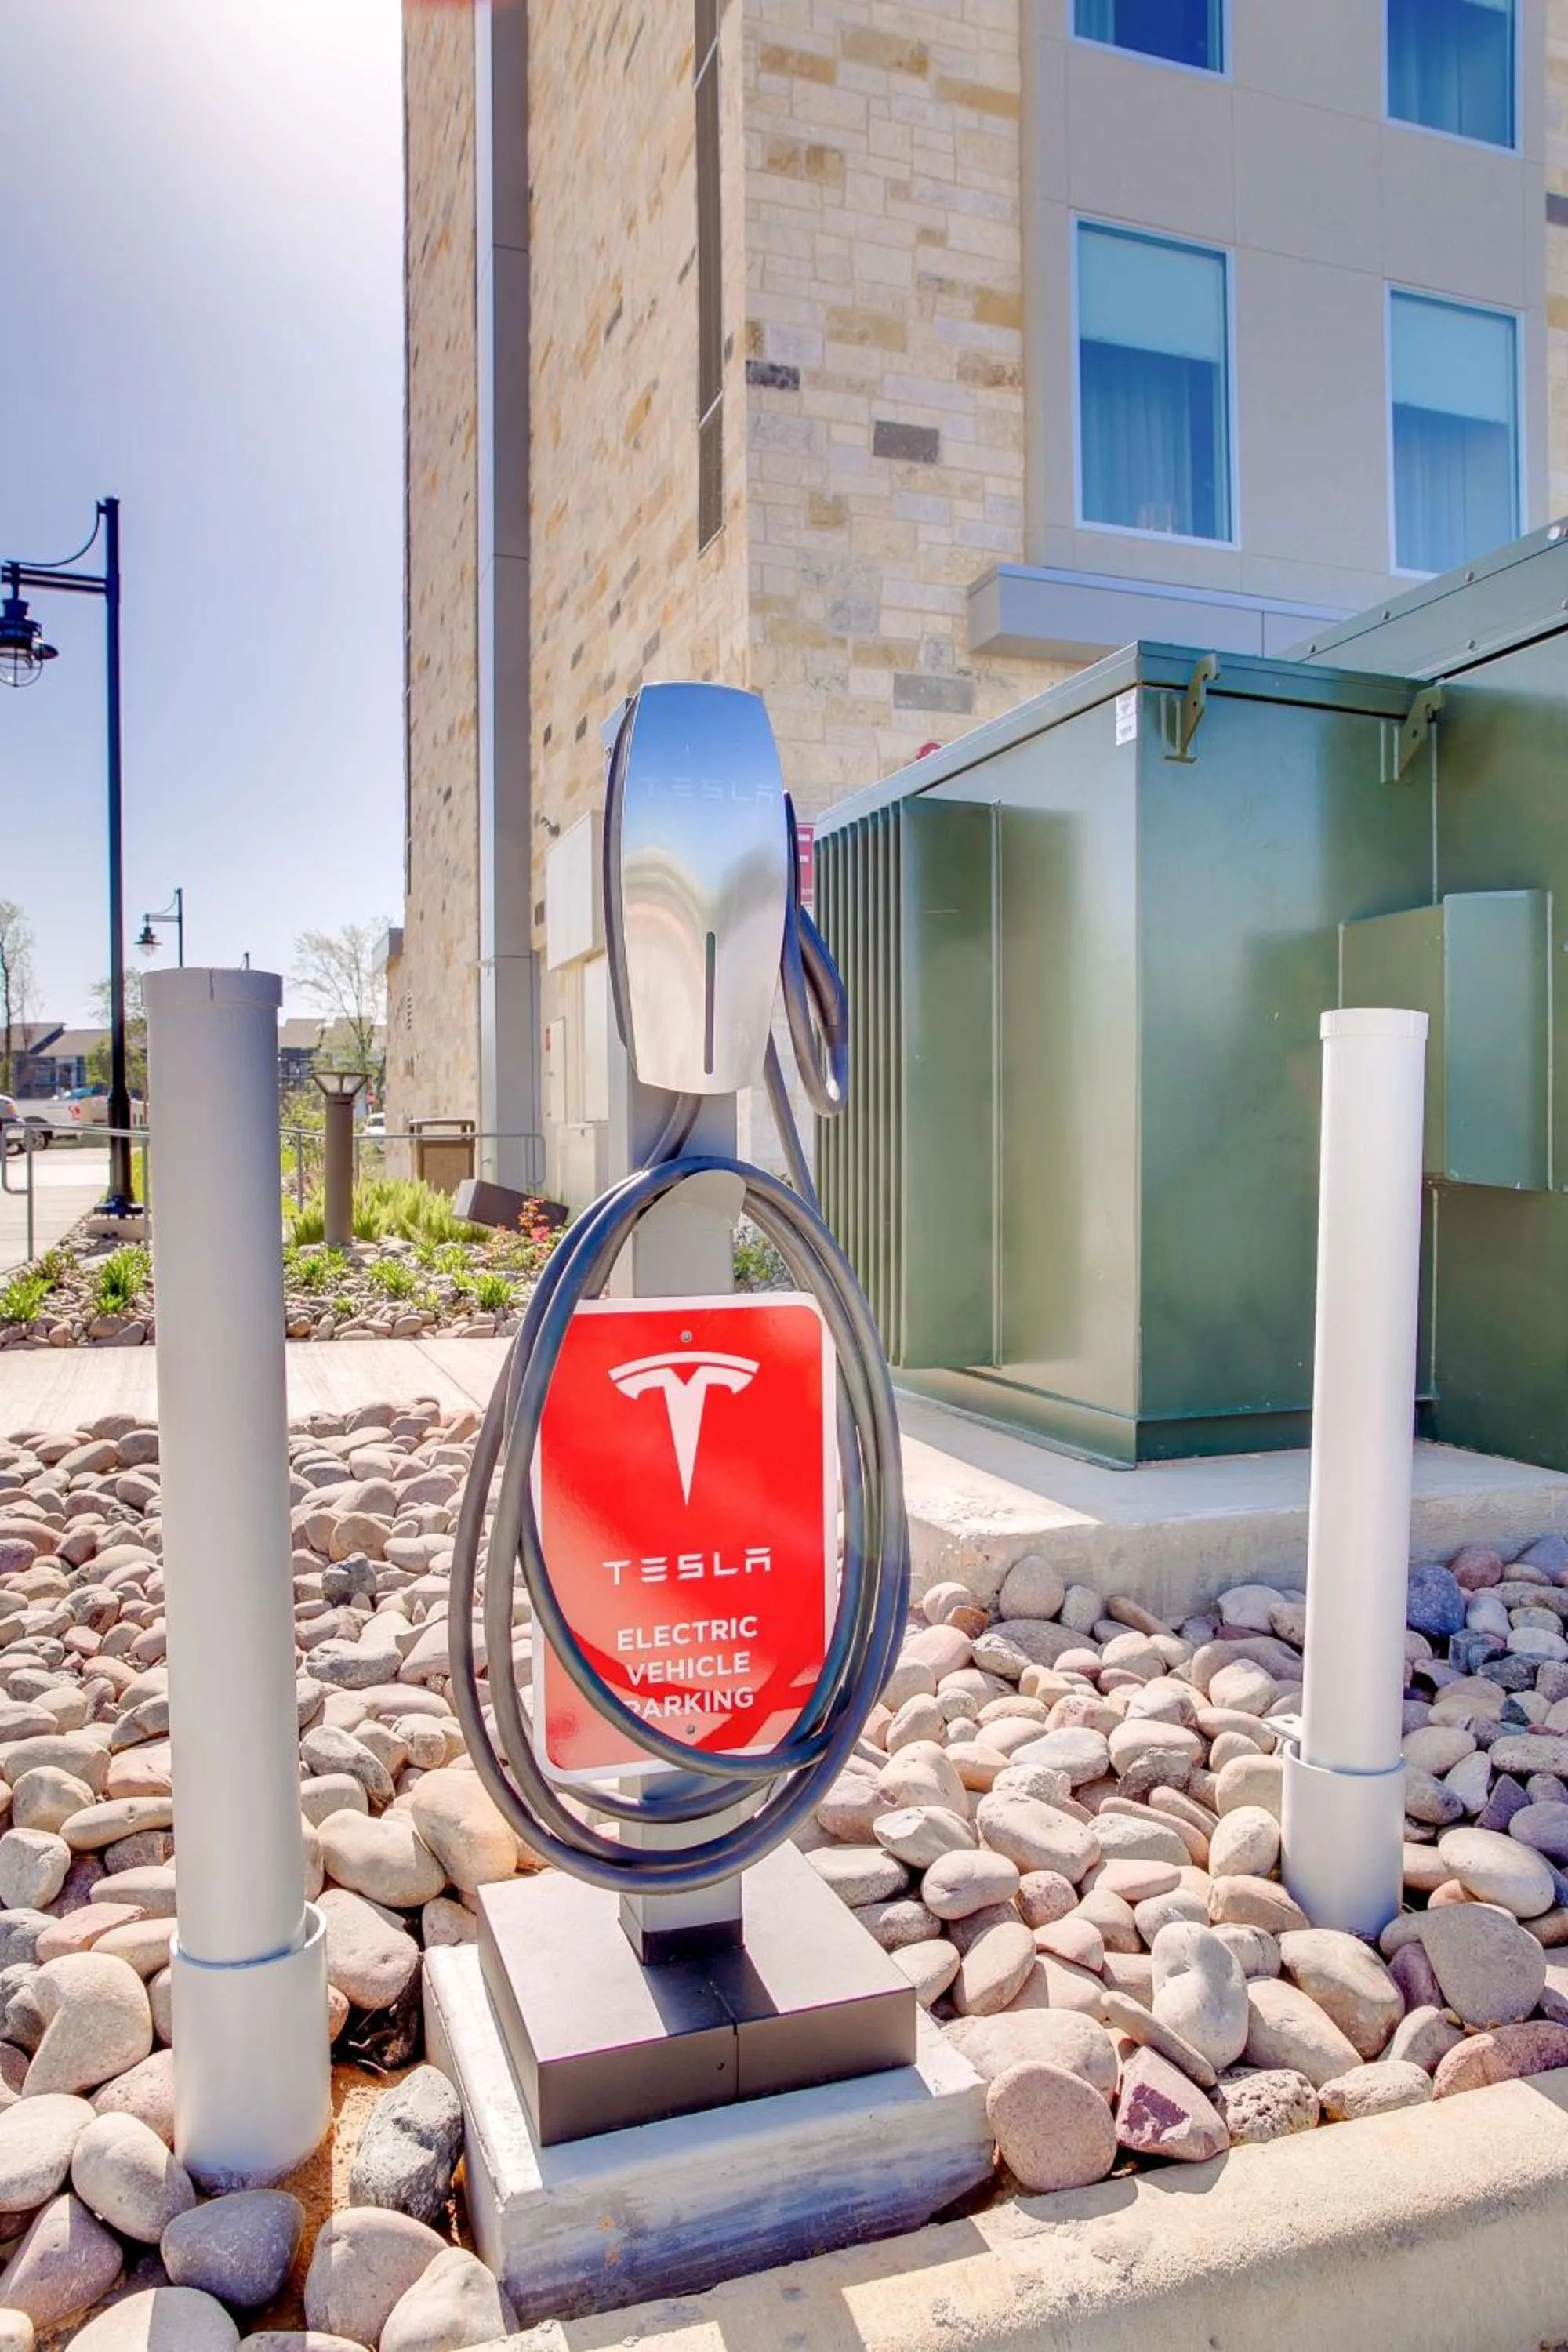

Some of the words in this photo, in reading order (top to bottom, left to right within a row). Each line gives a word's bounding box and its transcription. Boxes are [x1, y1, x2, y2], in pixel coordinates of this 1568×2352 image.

[637, 776, 775, 804] TESLA
[602, 1547, 771, 1585] TESLA
[617, 1615, 758, 1651] ELECTRIC
[626, 1650, 750, 1686] VEHICLE
